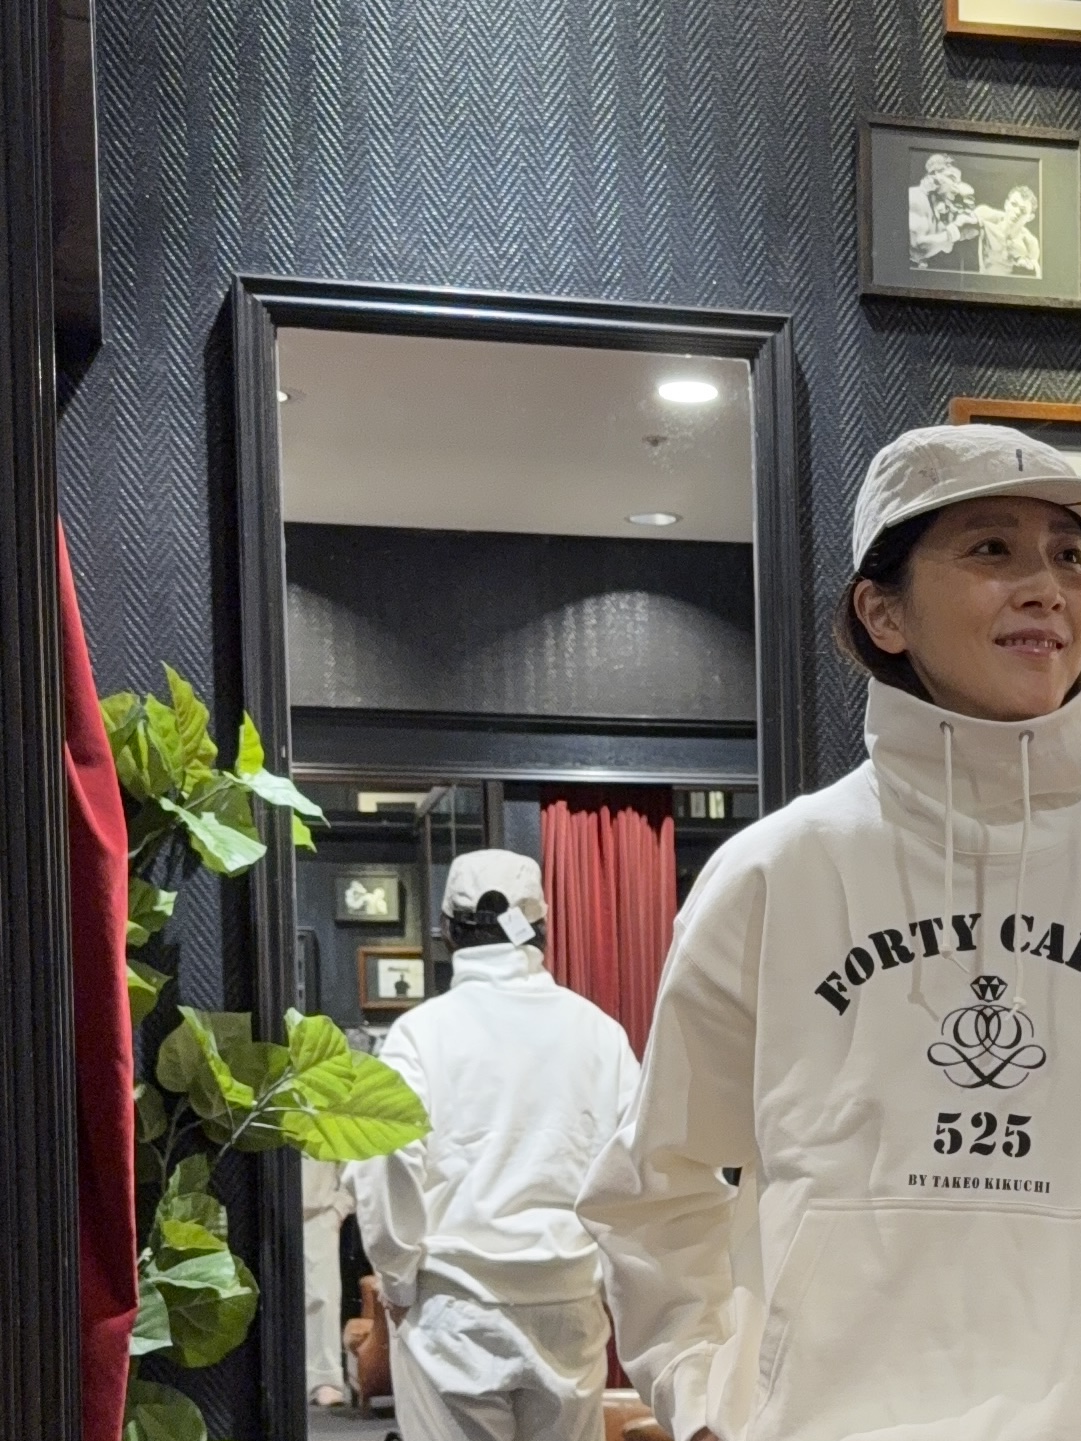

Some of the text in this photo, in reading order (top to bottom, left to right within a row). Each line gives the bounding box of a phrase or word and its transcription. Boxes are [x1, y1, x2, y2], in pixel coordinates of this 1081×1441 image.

[814, 912, 982, 1017] FORTY
[932, 1111, 1033, 1158] 525
[907, 1173, 1051, 1194] BY TAKEO KIKUCHI
